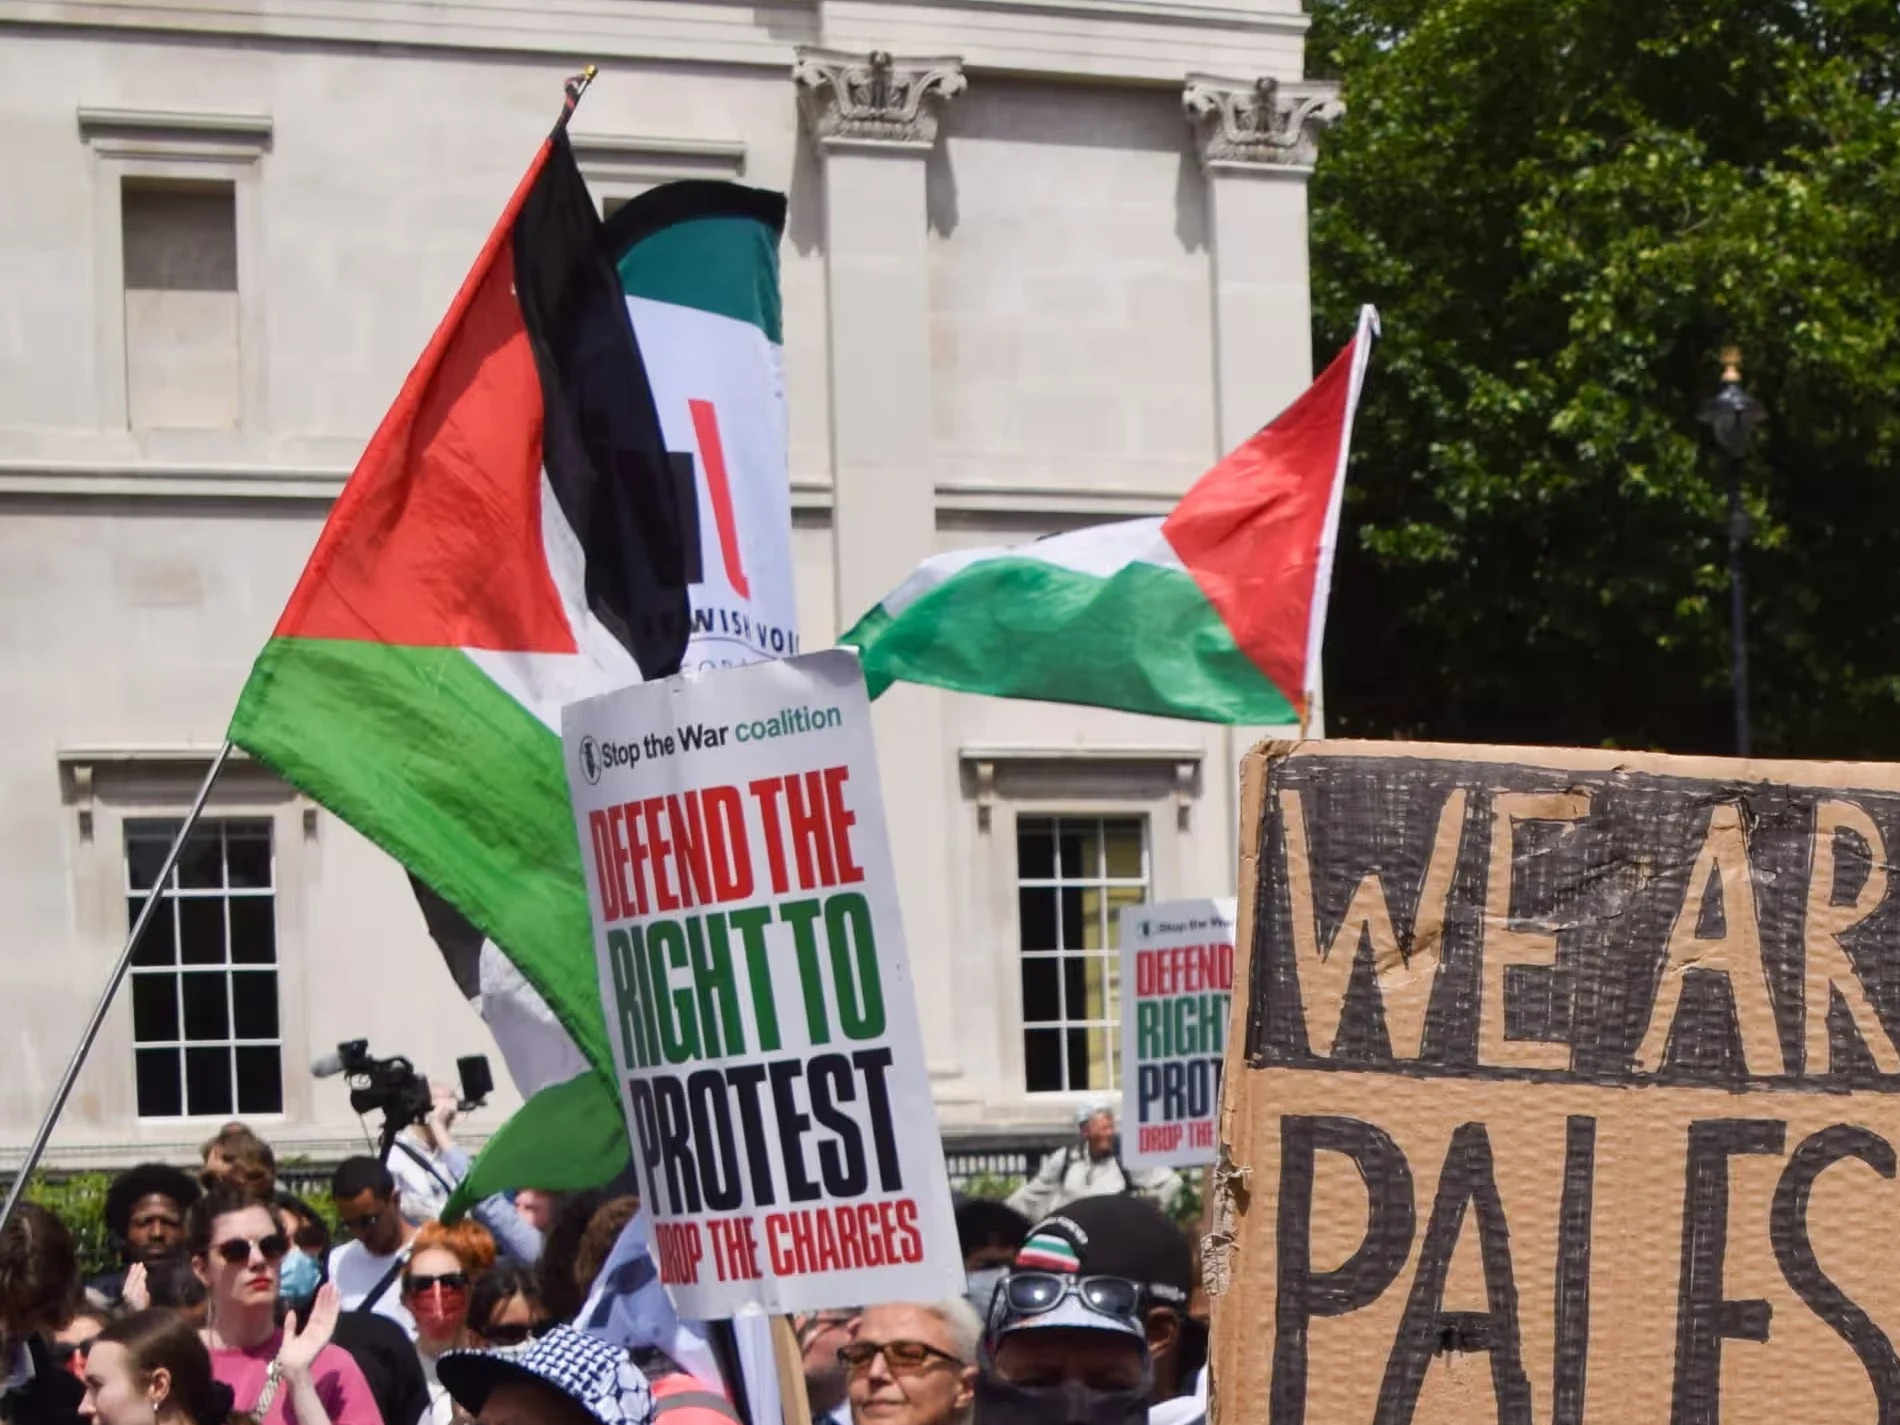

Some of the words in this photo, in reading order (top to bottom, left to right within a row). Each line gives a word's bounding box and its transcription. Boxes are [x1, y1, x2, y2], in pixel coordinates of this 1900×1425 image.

[602, 742, 640, 769] Stop
[644, 734, 675, 759] the
[677, 724, 729, 751] War
[735, 705, 842, 743] coalition
[589, 785, 754, 922] DEFEND
[749, 765, 865, 895] THE
[1136, 943, 1234, 997] DEFEND
[1279, 787, 1592, 1070] WE
[606, 905, 782, 1070] RIGHT
[780, 891, 887, 1047] TO
[629, 1047, 903, 1216] PROTEST
[1138, 1059, 1223, 1123] PROT
[1139, 1124, 1183, 1154] DROP
[656, 1221, 702, 1286] DROP
[706, 1216, 763, 1282] THE
[766, 1198, 924, 1277] CHARGES
